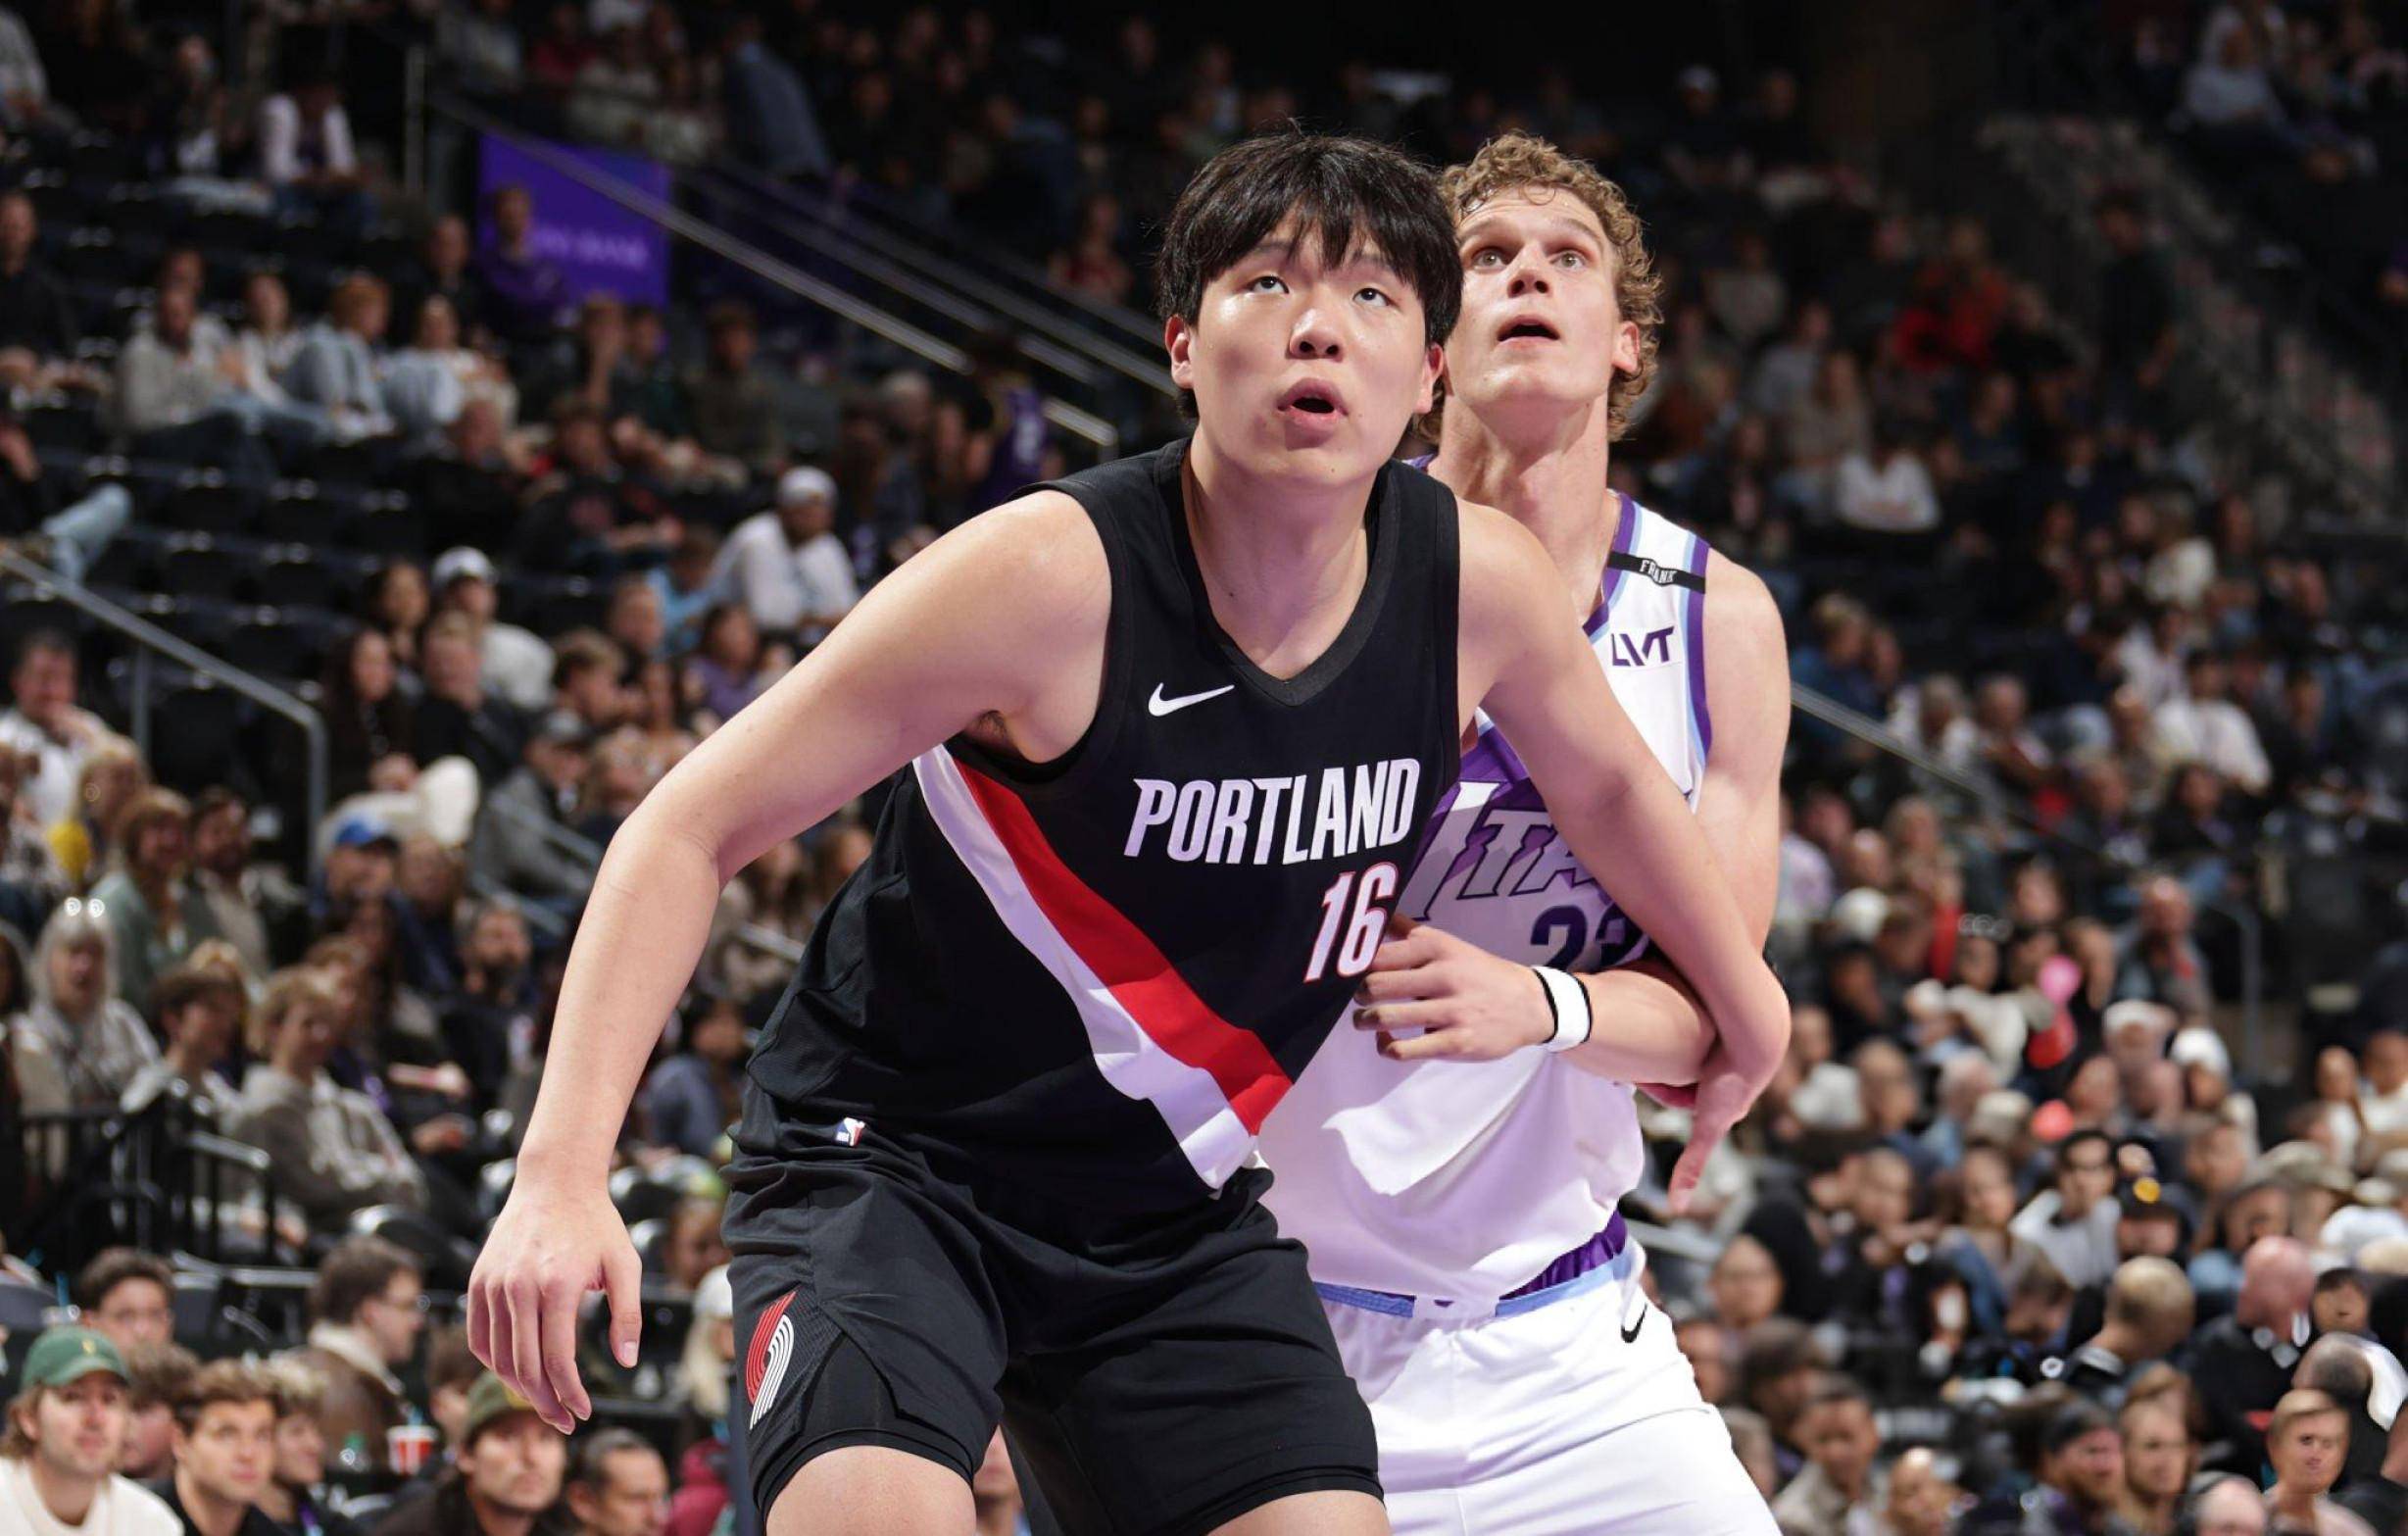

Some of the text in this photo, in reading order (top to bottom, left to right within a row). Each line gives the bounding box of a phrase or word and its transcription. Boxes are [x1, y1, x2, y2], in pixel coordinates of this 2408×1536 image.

[1639, 559, 1678, 584] FRANK
[1610, 625, 1675, 668] LVT
[1123, 757, 1421, 866] PORTLAND
[1303, 861, 1400, 984] 16
